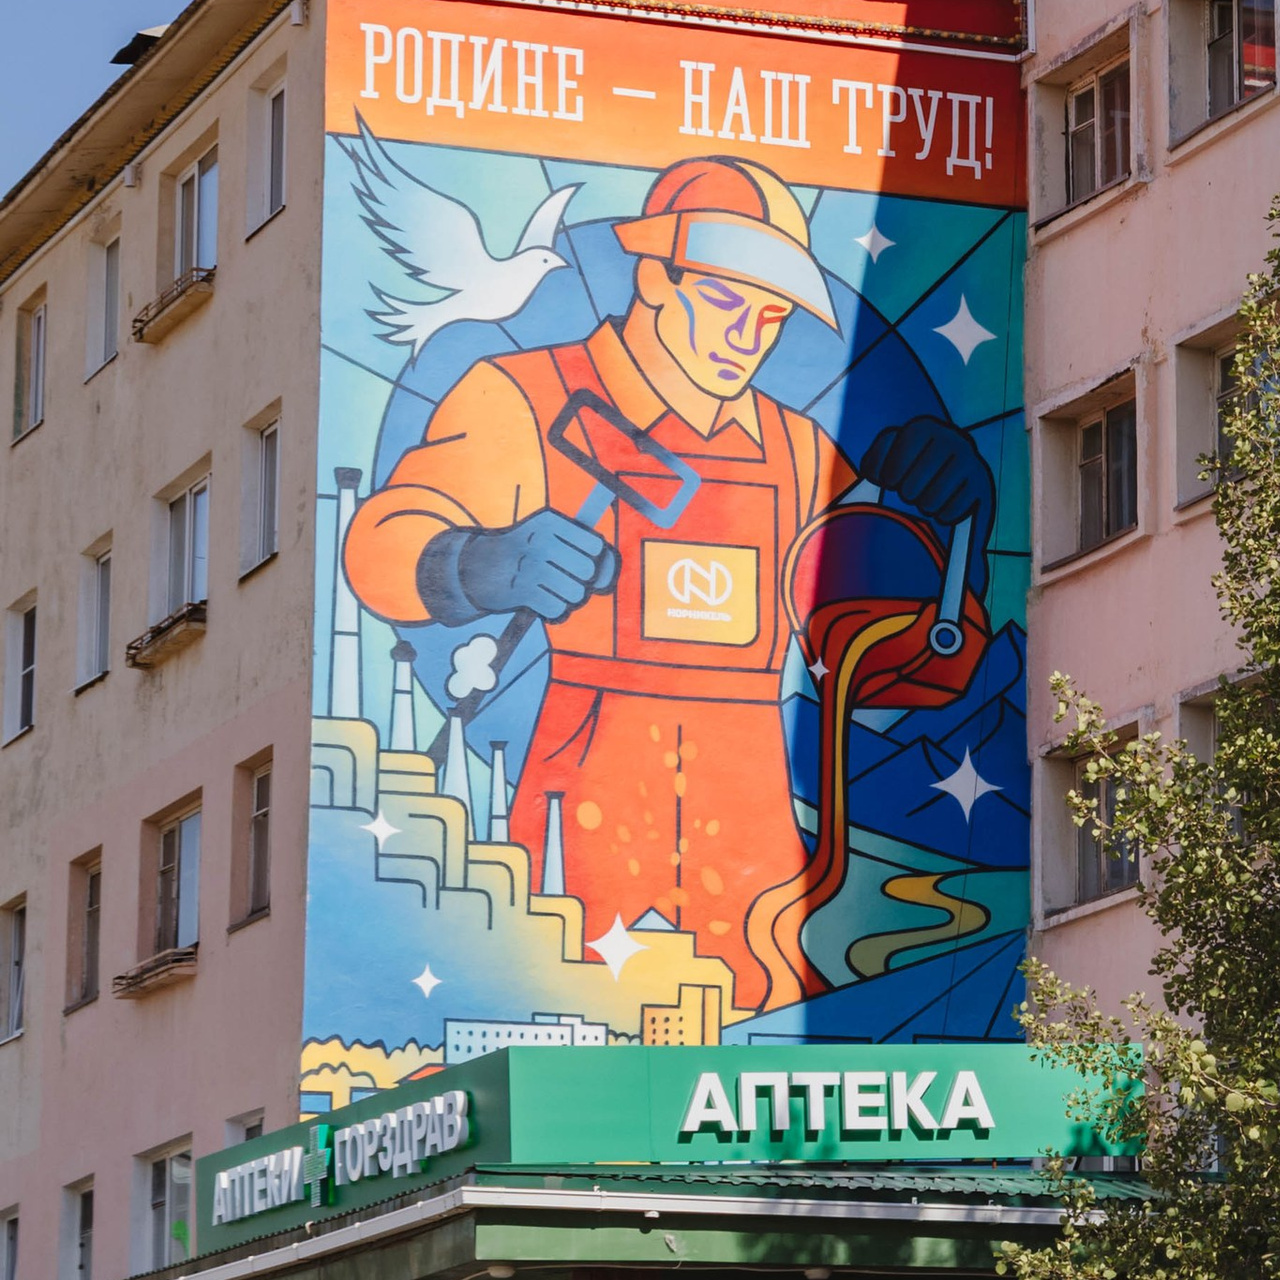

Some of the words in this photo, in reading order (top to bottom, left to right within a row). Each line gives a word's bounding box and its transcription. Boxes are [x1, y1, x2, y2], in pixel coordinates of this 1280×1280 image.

[359, 23, 584, 121] РОДИНЕ
[678, 60, 811, 149] НАШ
[831, 80, 995, 179] ТРУД!
[212, 1146, 305, 1226] АПТЕКИ
[333, 1090, 469, 1185] ГОРЗДРАВ
[680, 1071, 995, 1141] АПТЕКА
